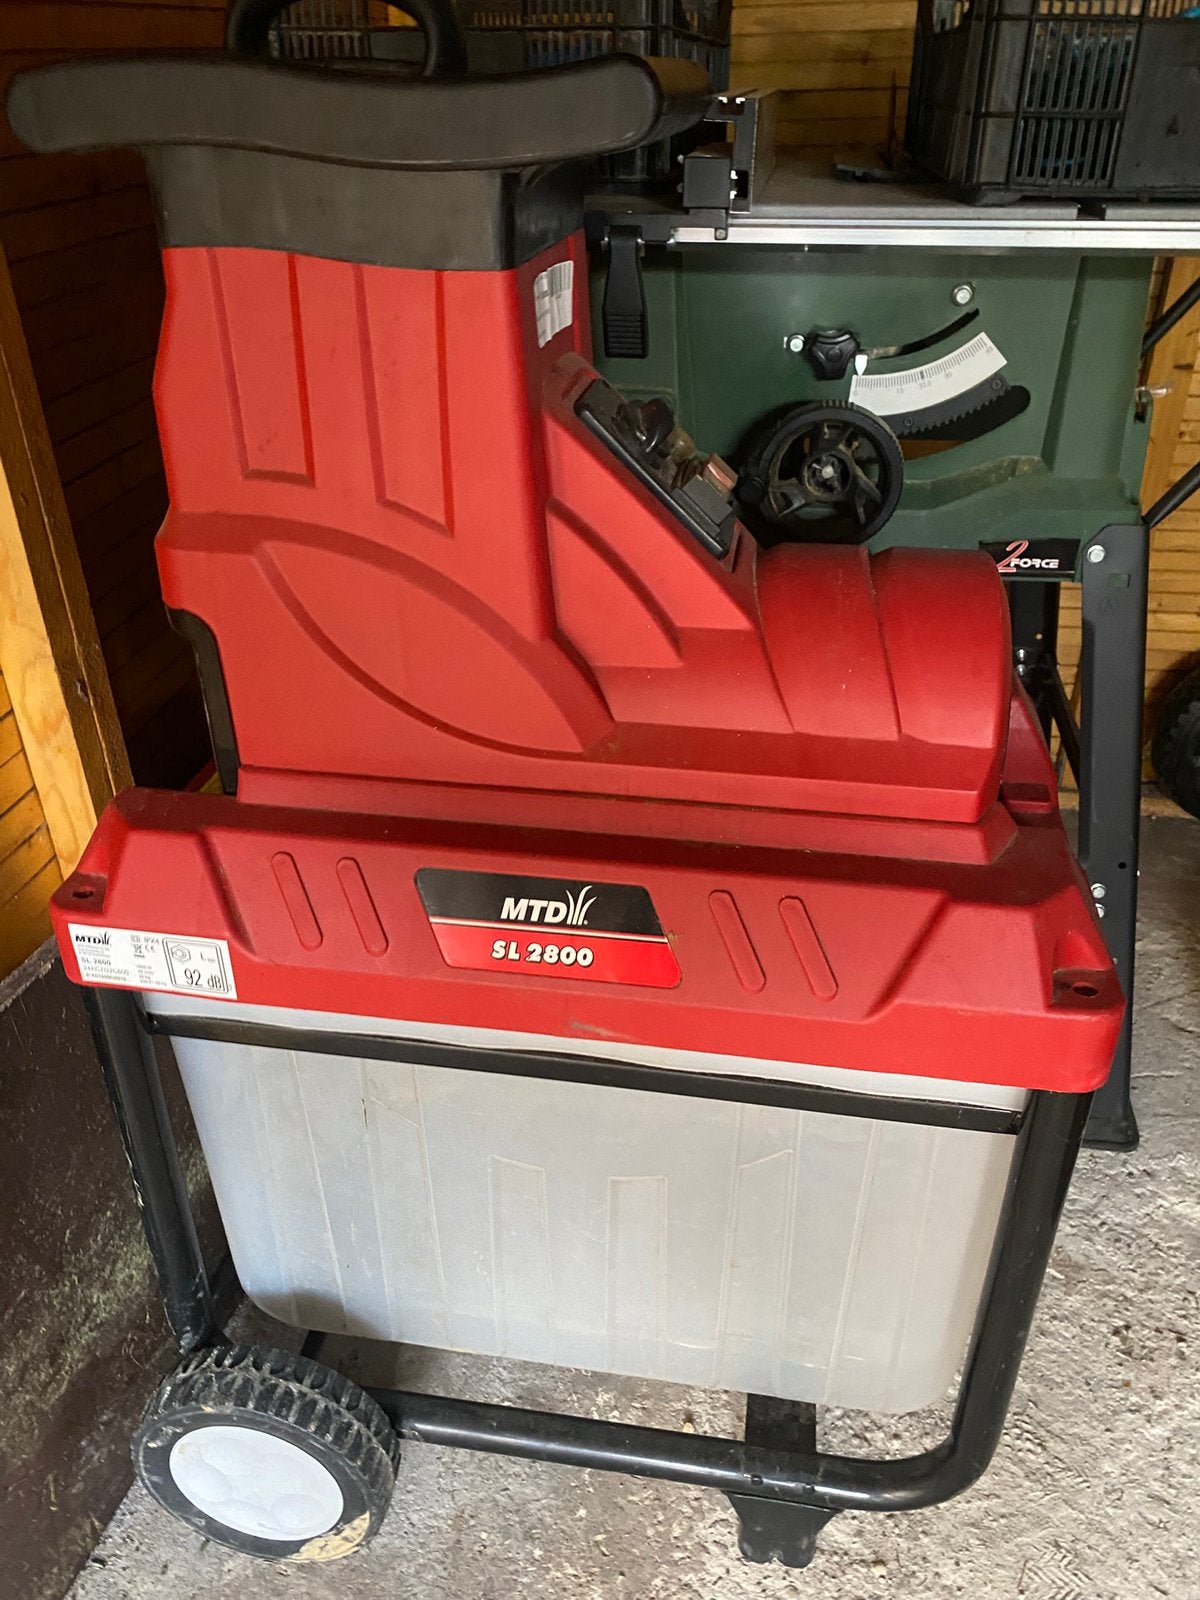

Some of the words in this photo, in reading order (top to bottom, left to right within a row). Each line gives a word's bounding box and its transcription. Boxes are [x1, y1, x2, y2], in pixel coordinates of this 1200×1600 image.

[500, 896, 569, 926] MTD
[75, 935, 102, 945] MTD
[491, 939, 521, 961] SL
[525, 943, 595, 968] 2800
[184, 968, 203, 986] 92
[207, 974, 222, 989] dB
